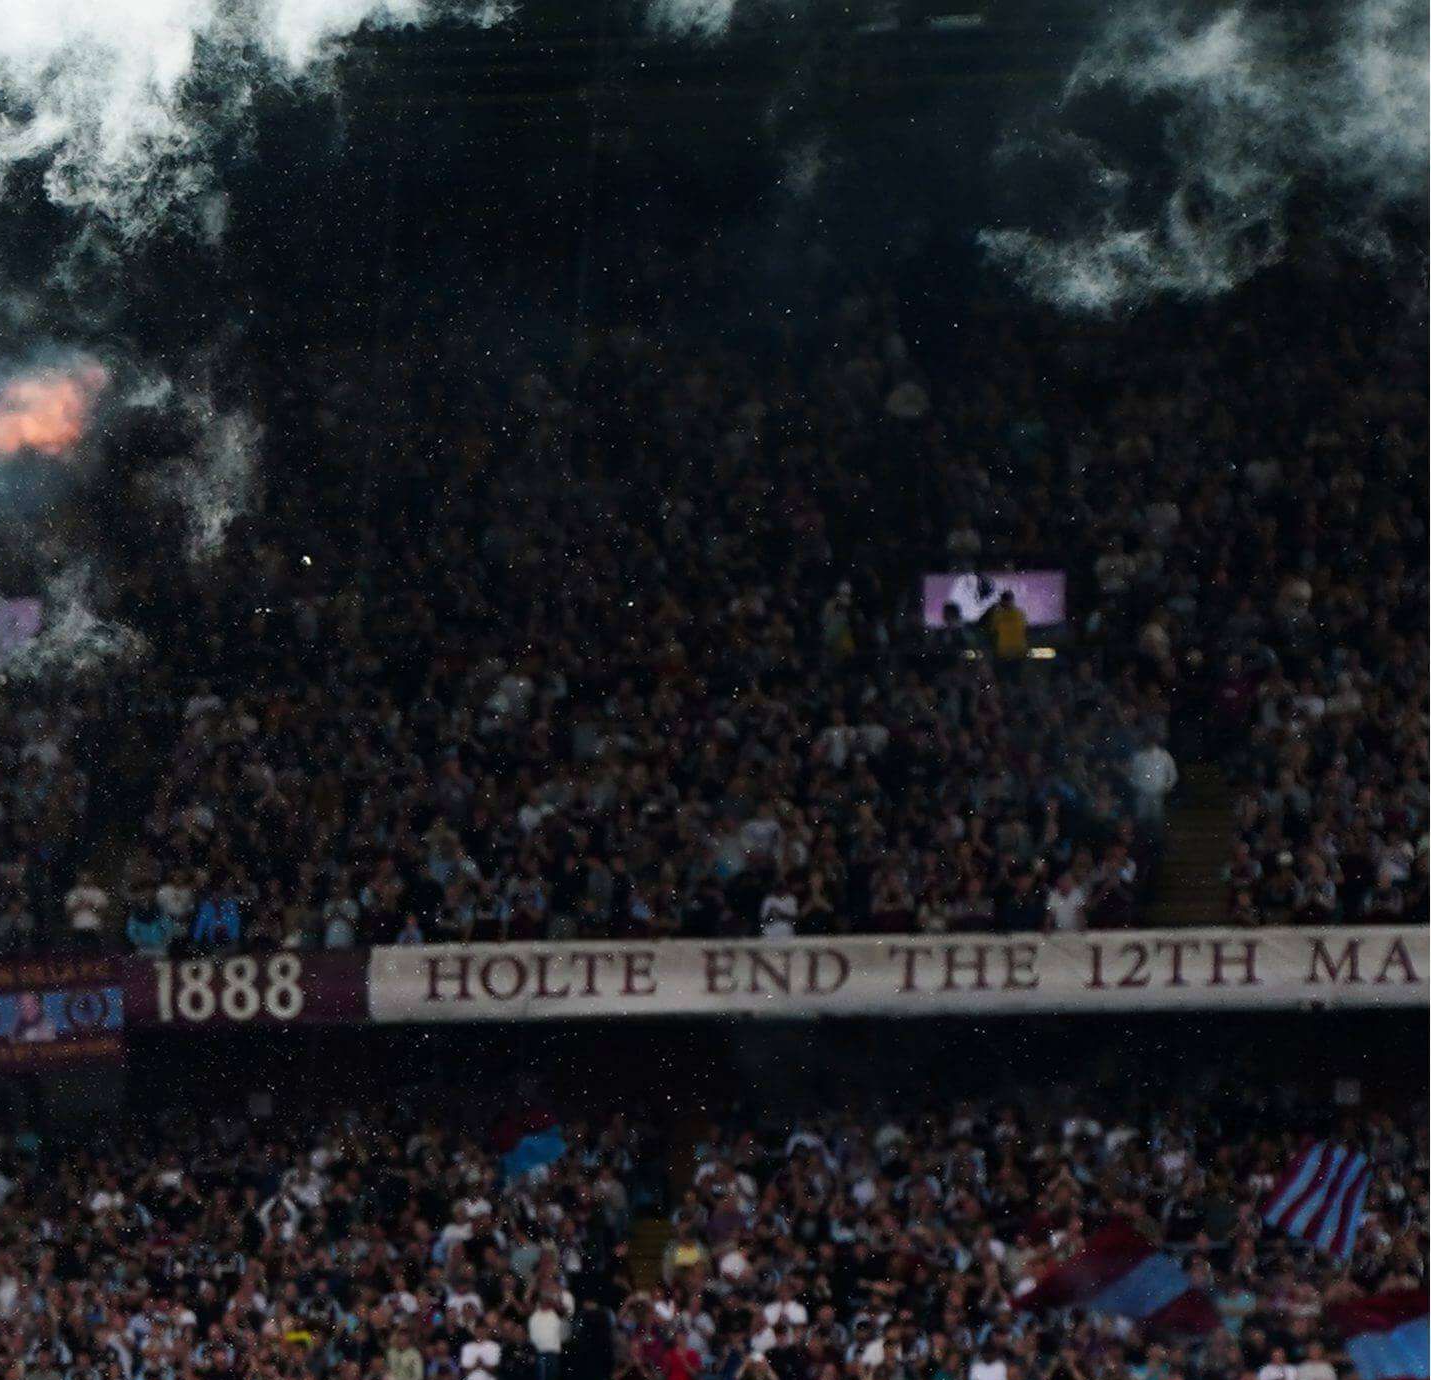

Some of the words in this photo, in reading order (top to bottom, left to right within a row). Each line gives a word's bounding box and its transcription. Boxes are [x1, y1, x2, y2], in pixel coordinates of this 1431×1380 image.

[153, 953, 305, 1022] 1888
[425, 950, 657, 1000] HOLTE
[702, 946, 852, 996] END
[889, 943, 1042, 993] THE
[1088, 939, 1262, 989] 12TH
